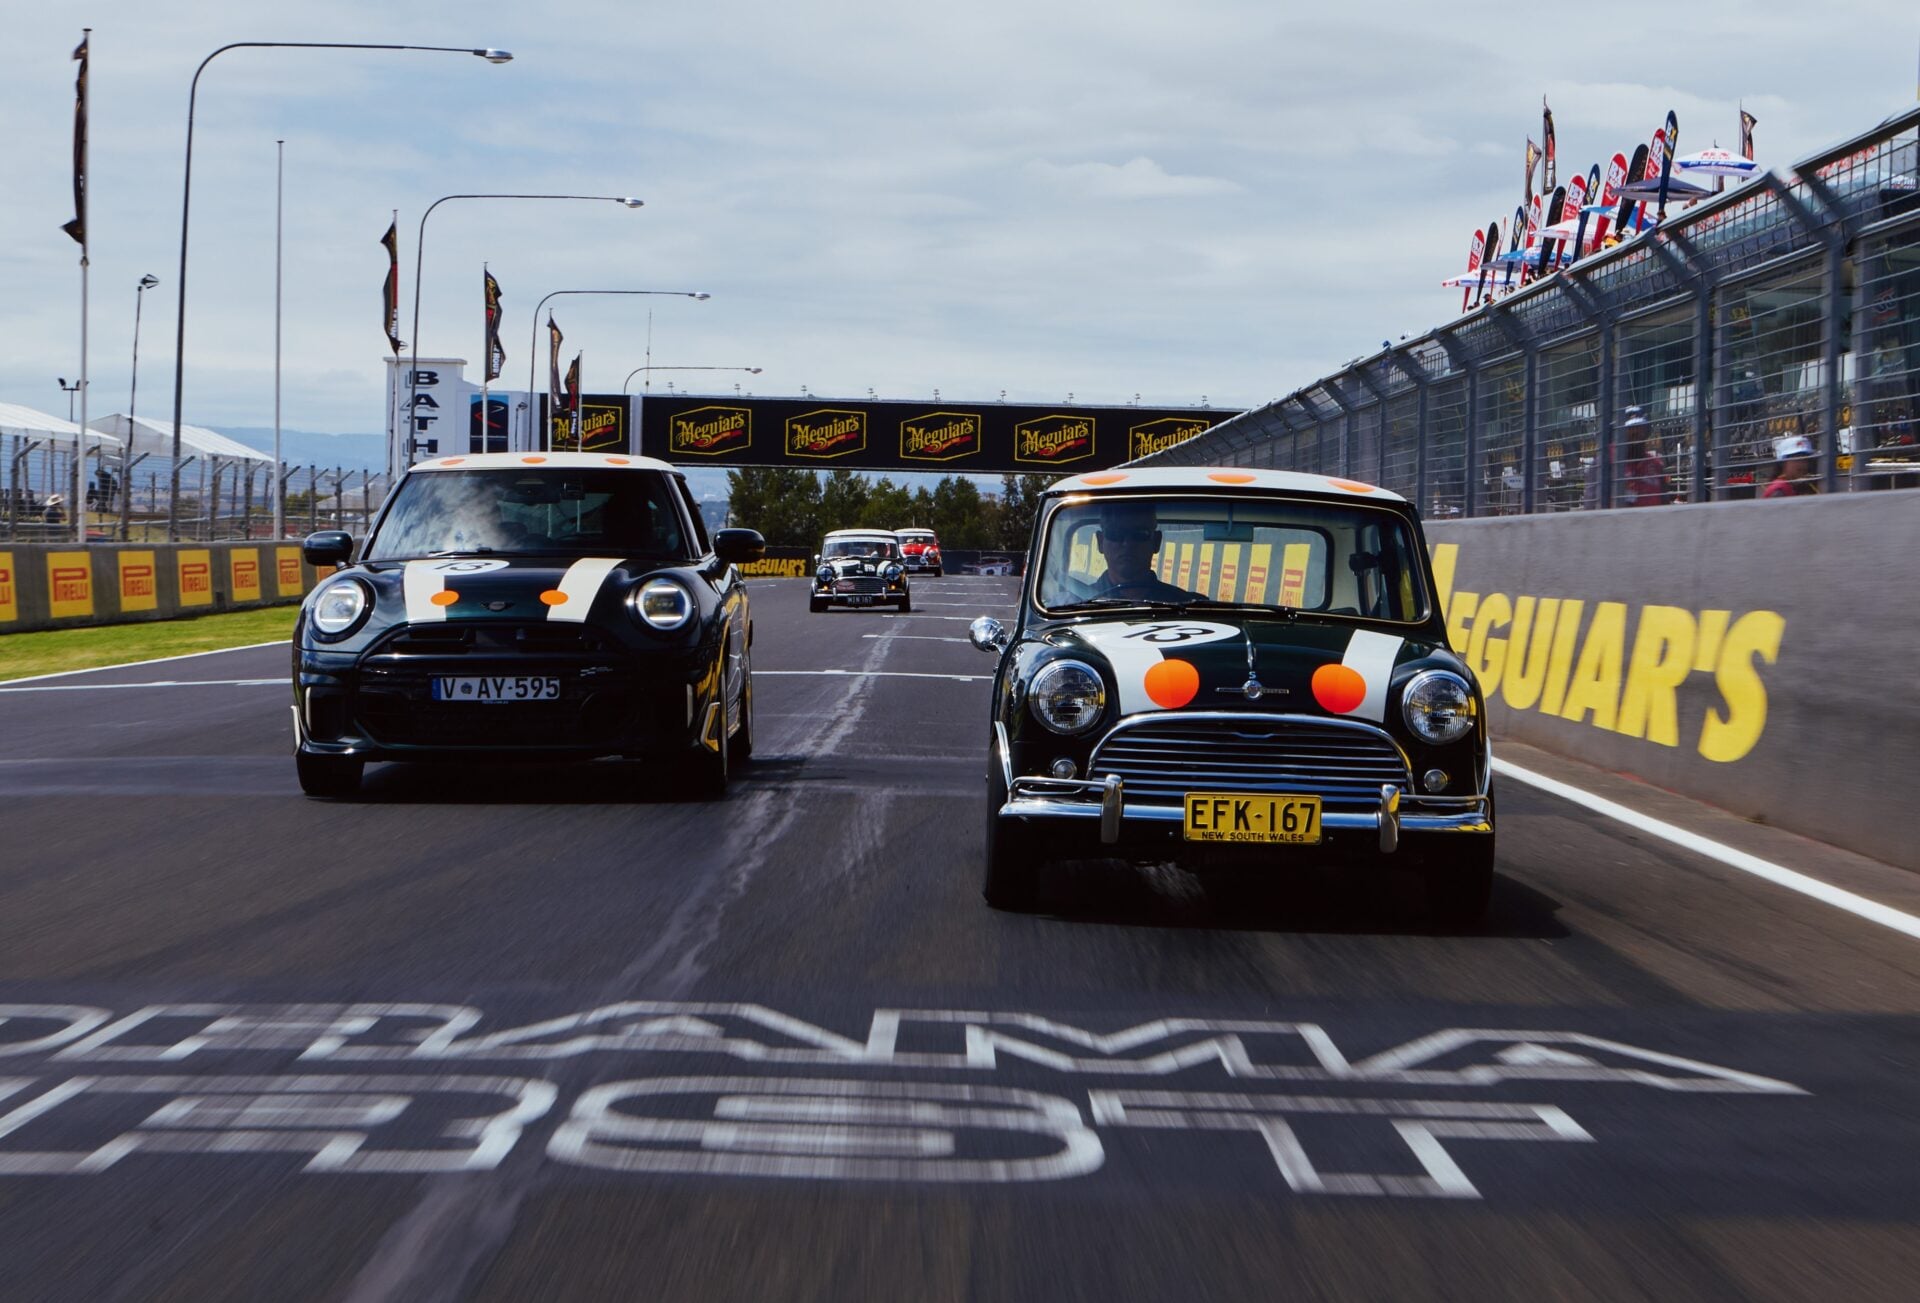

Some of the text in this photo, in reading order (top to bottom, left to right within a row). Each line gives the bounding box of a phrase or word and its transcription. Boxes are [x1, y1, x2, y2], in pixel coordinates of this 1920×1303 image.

[406, 371, 440, 464] BATH
[553, 409, 616, 441] Muiar's
[676, 412, 745, 447] Meguiar's
[791, 415, 859, 450] Meguiar's
[906, 418, 974, 453] Meguiar's
[1020, 421, 1089, 456] Meguiar's
[52, 567, 88, 602] PIRELLI
[122, 565, 152, 597] PIRELLI
[181, 563, 209, 593] PIRELLI
[234, 561, 257, 588] PIRELLI
[1122, 625, 1215, 642] 13
[1201, 831, 1305, 842] NEW SOUTH WALES
[0, 1001, 1812, 1096] RAMA
[0, 1074, 1596, 1200] RST
